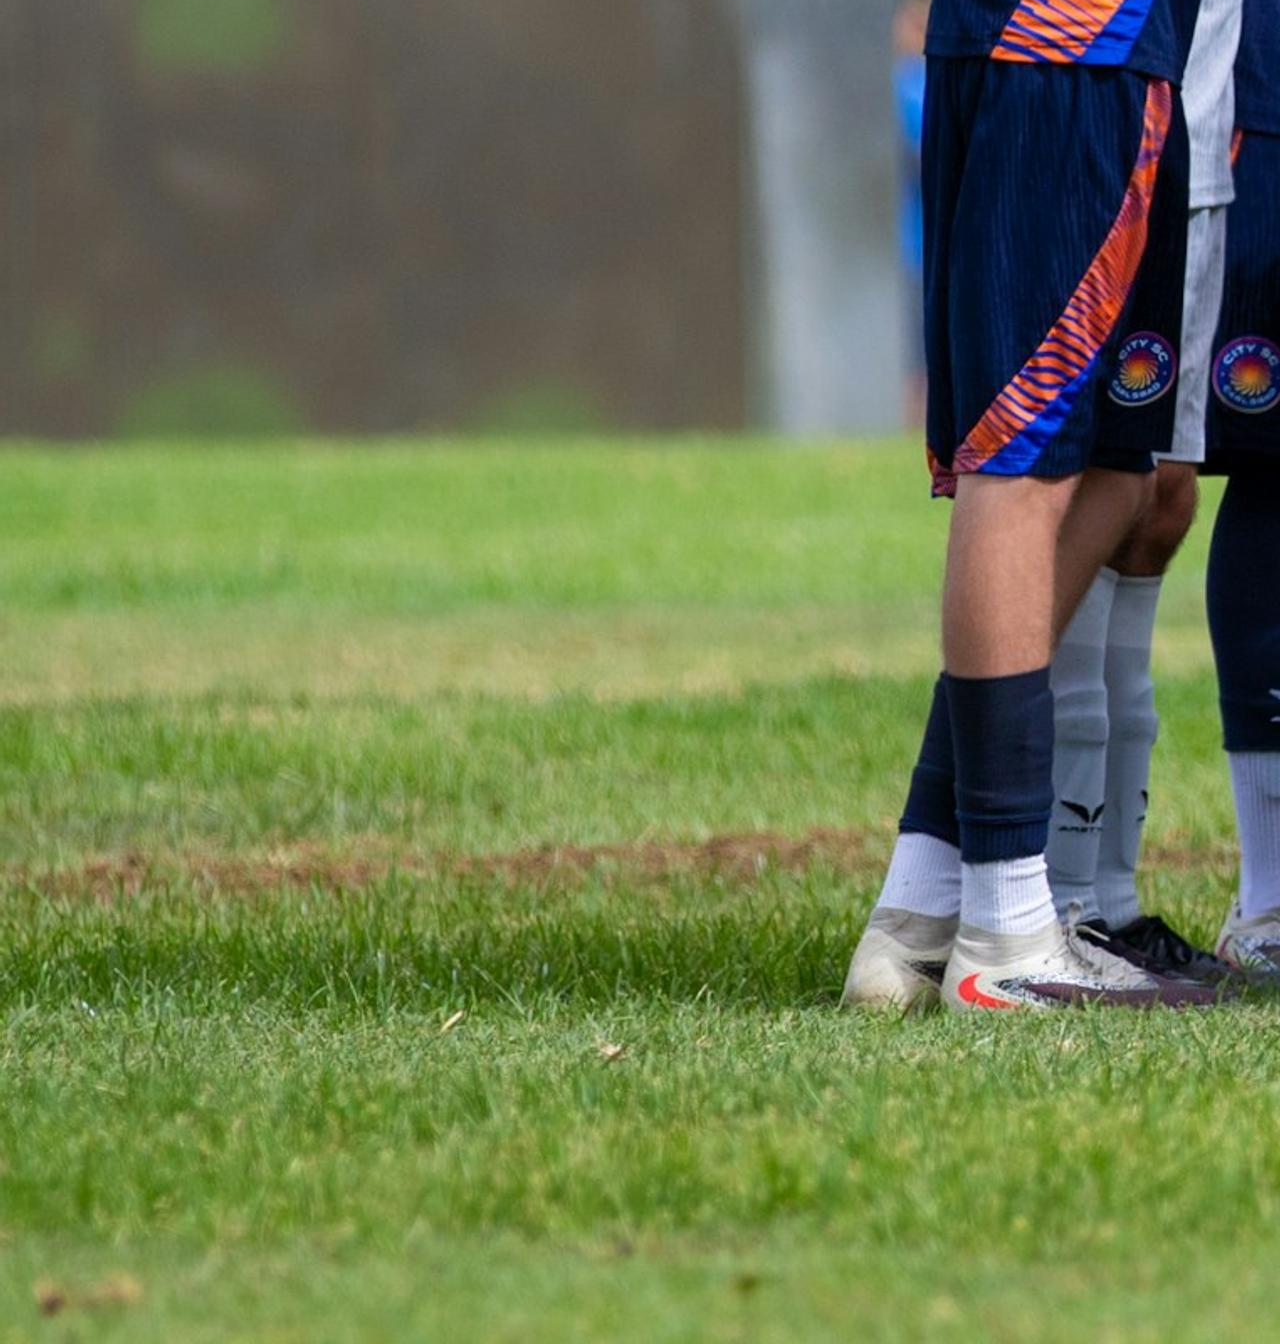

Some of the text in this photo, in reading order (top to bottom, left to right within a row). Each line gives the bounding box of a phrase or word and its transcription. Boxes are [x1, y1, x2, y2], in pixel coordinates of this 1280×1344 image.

[1119, 339, 1168, 363] CITY SC
[1223, 343, 1279, 366] CITY SC
